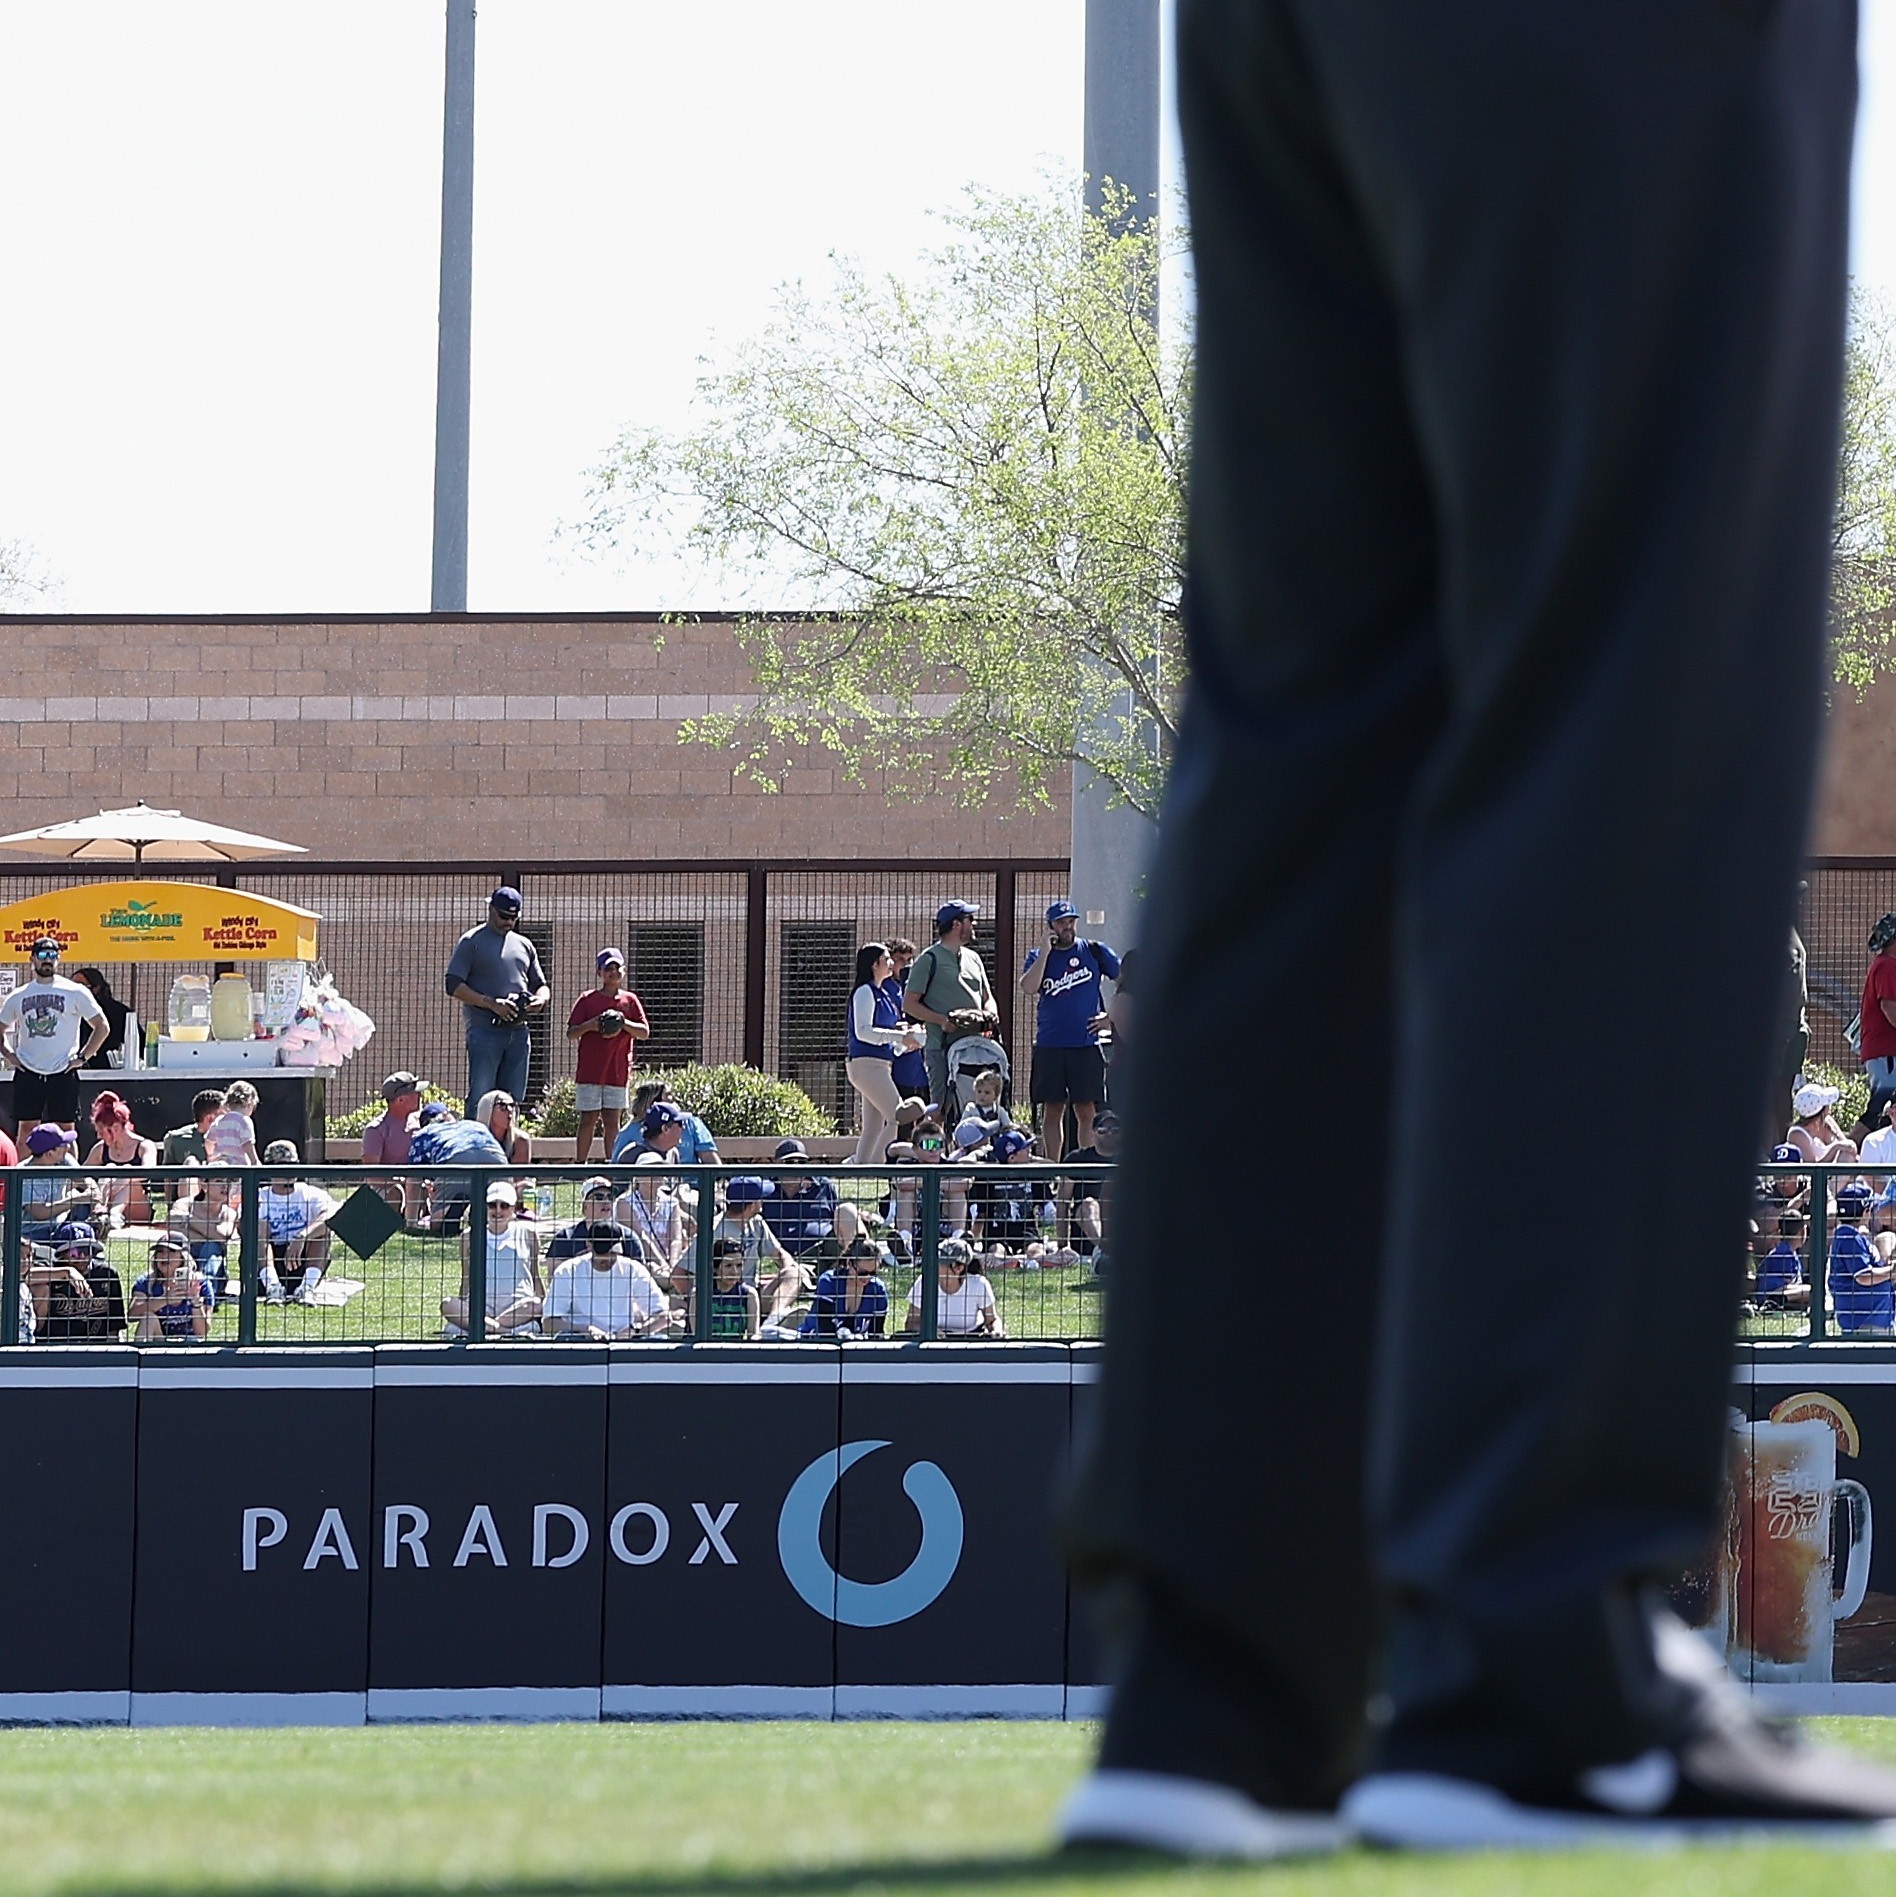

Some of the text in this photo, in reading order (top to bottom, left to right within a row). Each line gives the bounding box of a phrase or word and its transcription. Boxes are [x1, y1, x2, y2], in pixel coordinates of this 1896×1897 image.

[100, 912, 183, 928] LEMONADE
[4, 930, 78, 944] Kettle Corn
[203, 927, 277, 941] Kettle Corn
[1042, 966, 1093, 996] Dodgers
[242, 1501, 739, 1571] PARADOX
